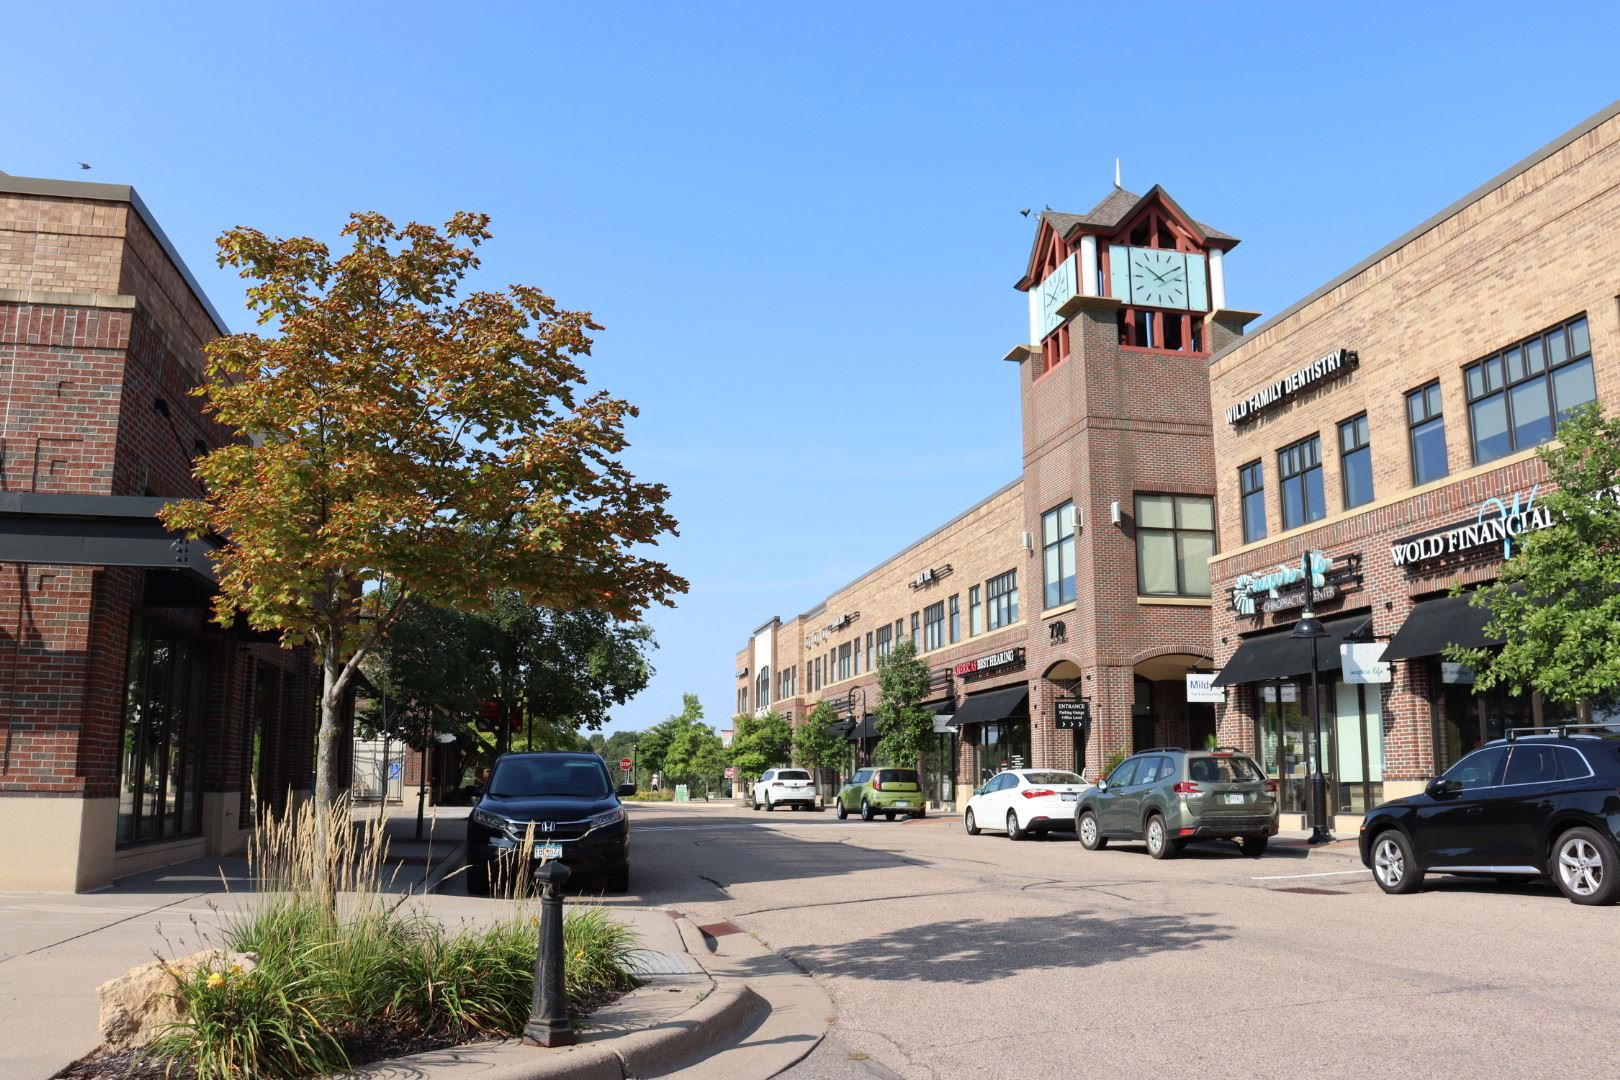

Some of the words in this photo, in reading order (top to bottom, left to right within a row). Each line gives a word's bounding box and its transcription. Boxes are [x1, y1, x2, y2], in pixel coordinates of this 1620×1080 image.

[1224, 400, 1247, 424] WILD
[1249, 380, 1283, 413] FAMILY
[1284, 349, 1342, 394] DENTISTRY
[1390, 536, 1444, 567] WOLD
[1447, 504, 1556, 553] FINANCIAL
[1263, 592, 1306, 613] CHIROPRACTIC
[1312, 586, 1335, 602] ENTER
[977, 656, 989, 671] BEST
[989, 649, 1014, 667] HEARING
